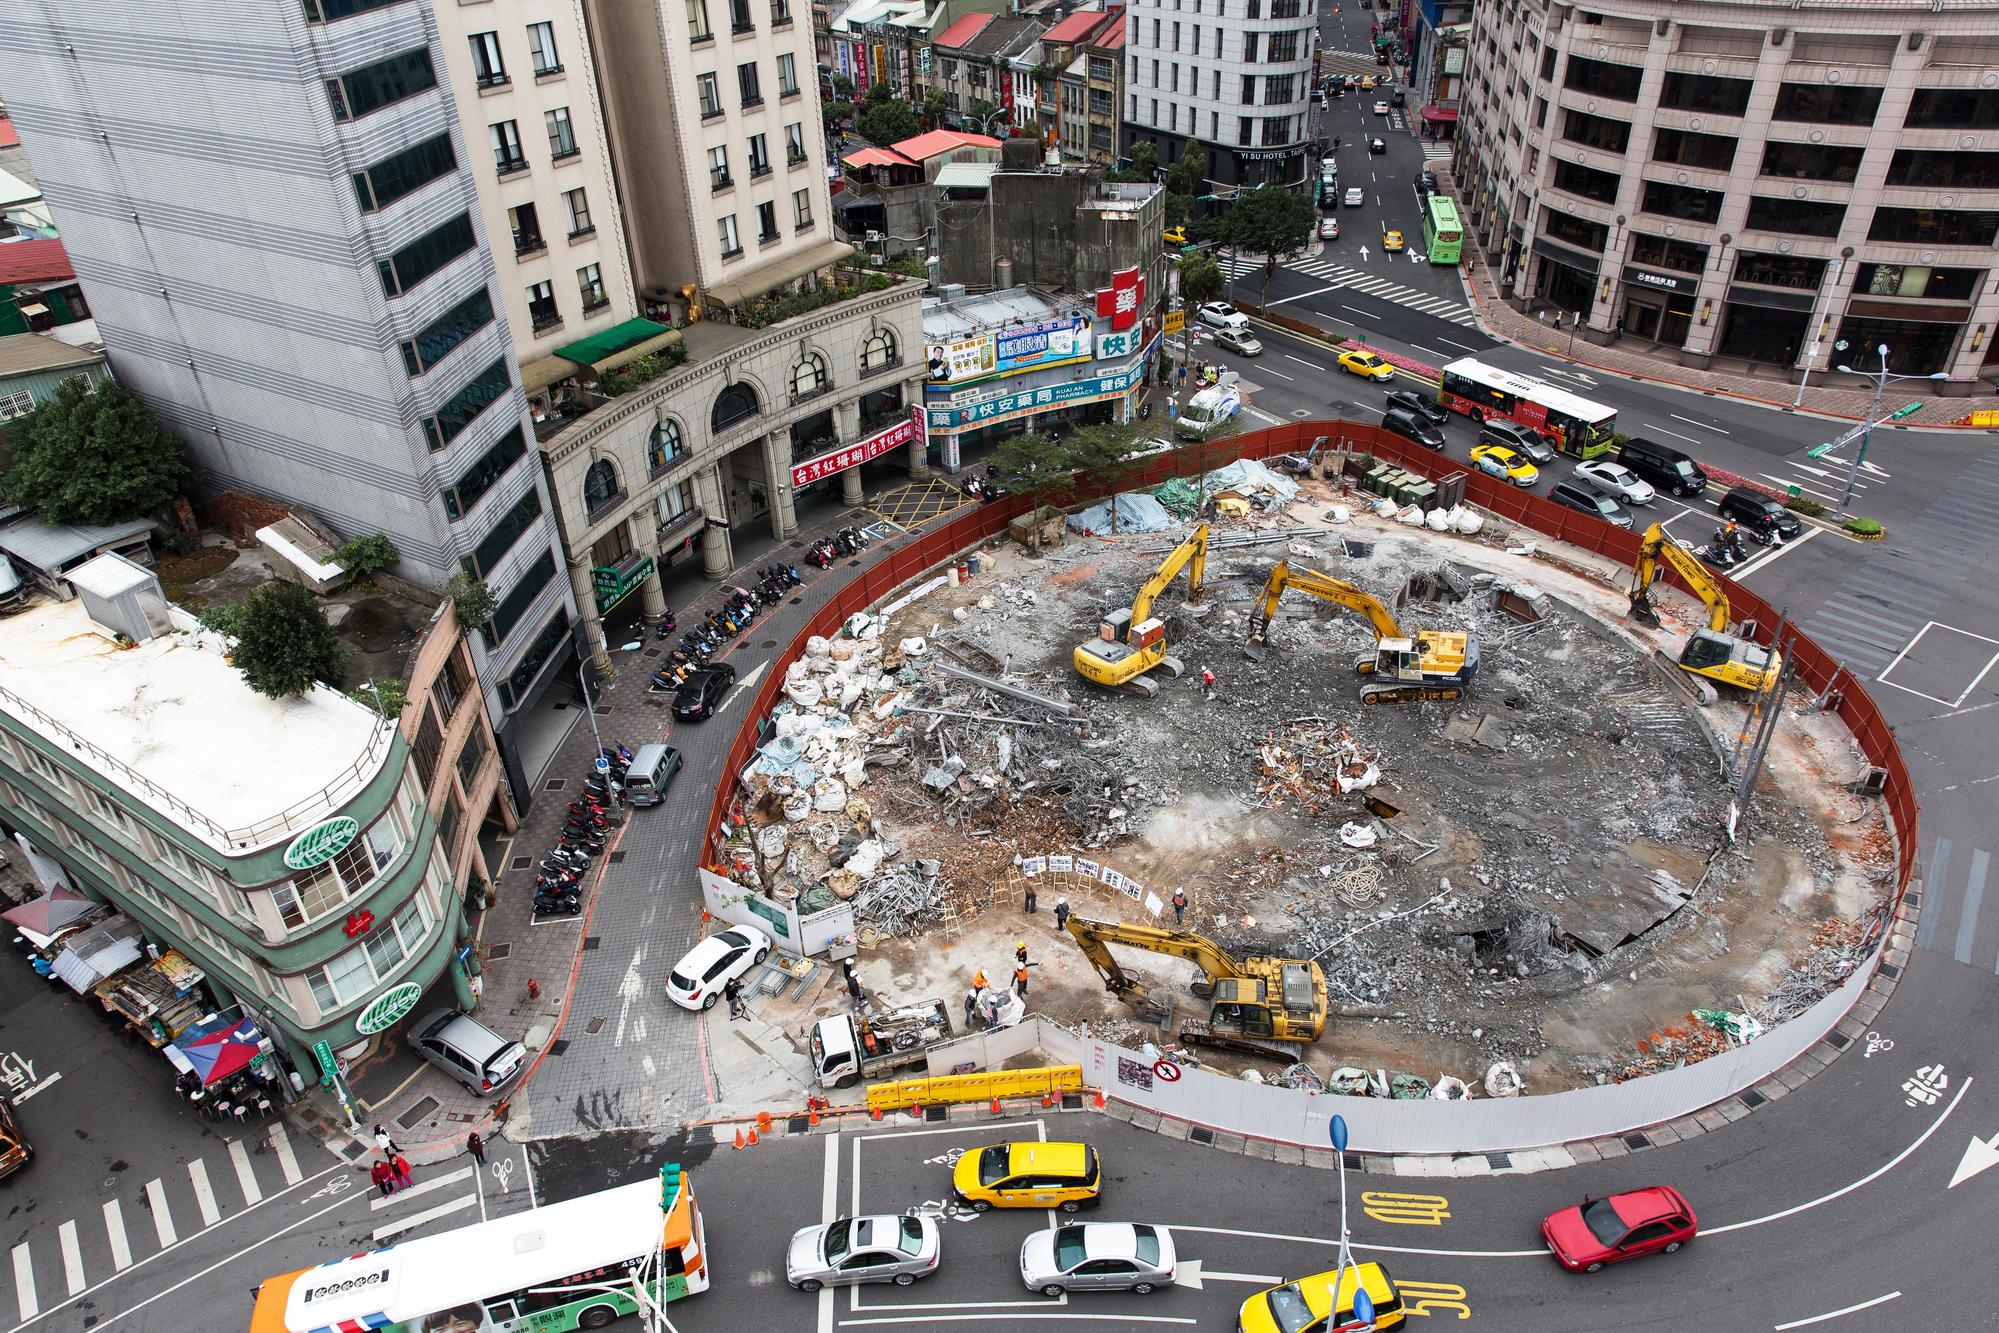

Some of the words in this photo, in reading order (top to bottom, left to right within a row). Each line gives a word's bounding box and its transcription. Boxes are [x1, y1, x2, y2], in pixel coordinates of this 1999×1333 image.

[1102, 327, 1141, 357] 快安
[979, 389, 1053, 417] 快安藥局
[1055, 389, 1095, 400] PHARMACY
[869, 425, 912, 456] 台灣紅珊瑚
[796, 448, 863, 484] 台灣紅珊瑚
[1670, 555, 1696, 580] SUMITOMO
[1111, 937, 1150, 950] KOMATSU
